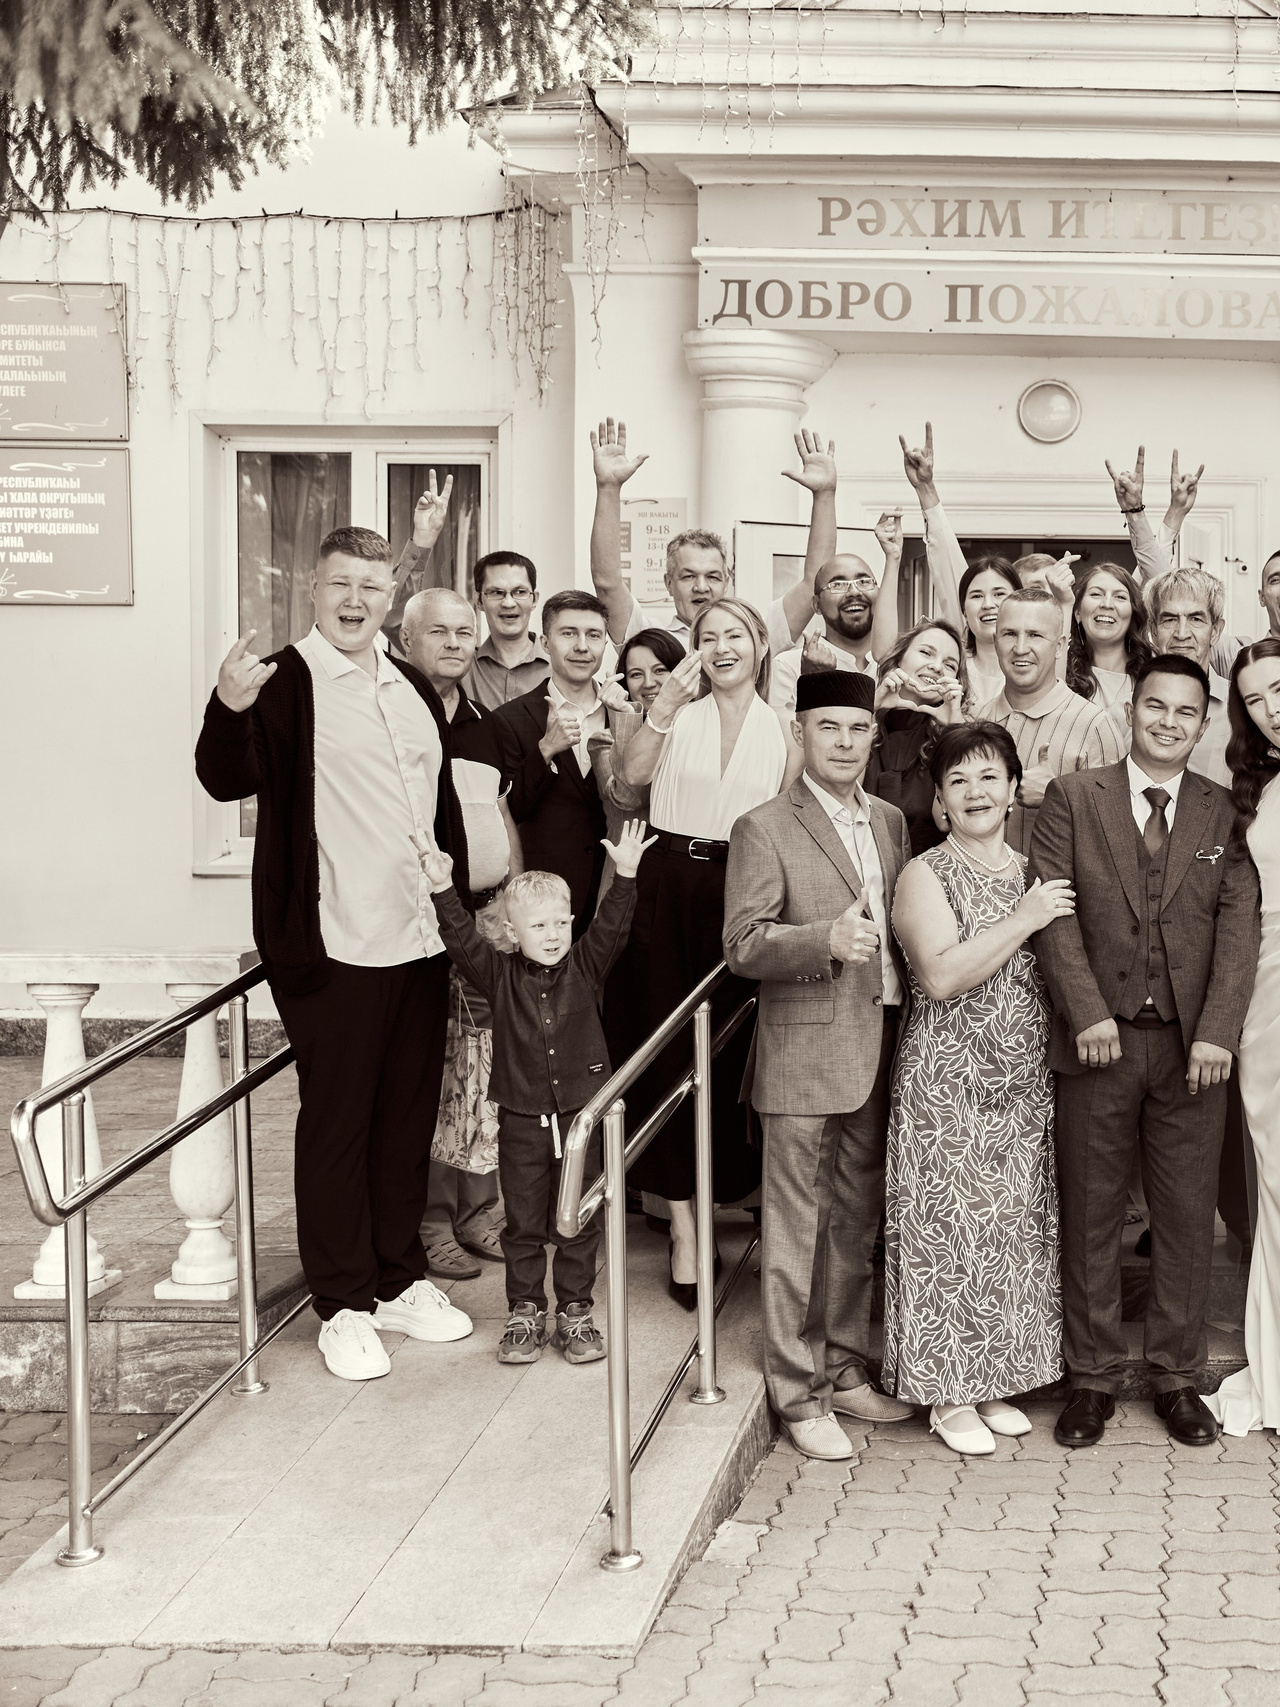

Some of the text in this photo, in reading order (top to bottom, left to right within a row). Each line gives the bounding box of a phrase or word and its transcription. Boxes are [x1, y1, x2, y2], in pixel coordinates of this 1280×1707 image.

[817, 197, 1026, 239] РӘХИМ
[712, 279, 912, 327] ДОБРО
[0, 338, 66, 351] РЕ БУЙЫНСА
[0, 522, 13, 534] ЕТ
[646, 524, 670, 535] 9-18
[647, 542, 667, 550] 13-1
